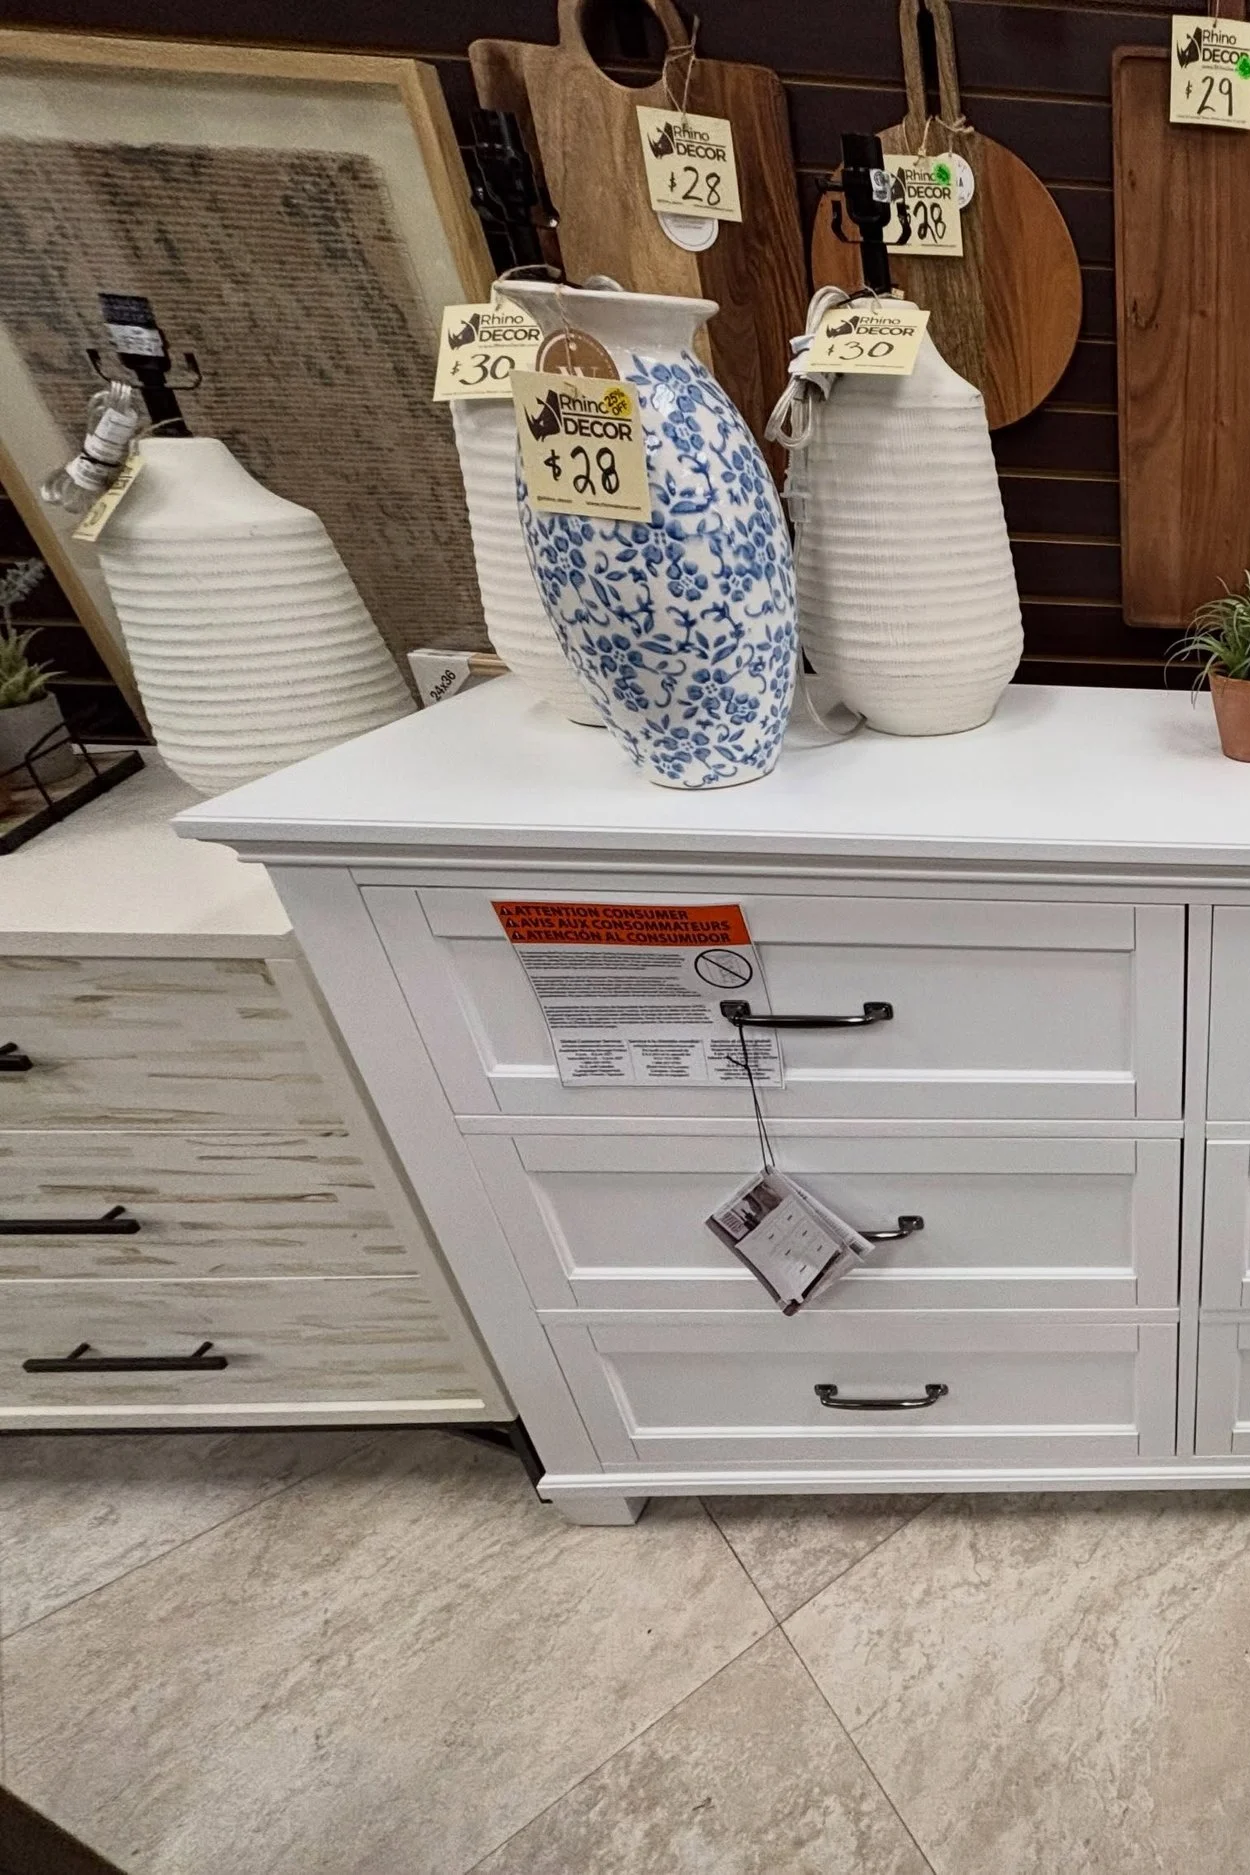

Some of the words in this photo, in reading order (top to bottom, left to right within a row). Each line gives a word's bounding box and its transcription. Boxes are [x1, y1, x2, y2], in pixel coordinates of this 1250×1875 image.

[1203, 29, 1237, 46] Rhino
[673, 125, 710, 142] Rhino
[676, 142, 727, 163] DECOR
[907, 185, 951, 200] DECOR
[481, 313, 524, 326] Rhino
[859, 316, 901, 325] Rhino
[480, 328, 541, 343] DECOR
[856, 326, 915, 337] DECOR
[612, 400, 628, 416] OFF
[563, 417, 633, 442] DECOR
[430, 669, 457, 701] 24x36
[513, 905, 600, 919] ATTENTION
[602, 907, 689, 920] CONSUMER
[521, 917, 555, 928] AVIS
[557, 918, 588, 930] AUX
[592, 919, 731, 932] CONSOMMATEURS
[526, 928, 601, 942] ATENCIÓN
[605, 931, 625, 943] AL
[627, 931, 731, 943] CONSUMIDOR
